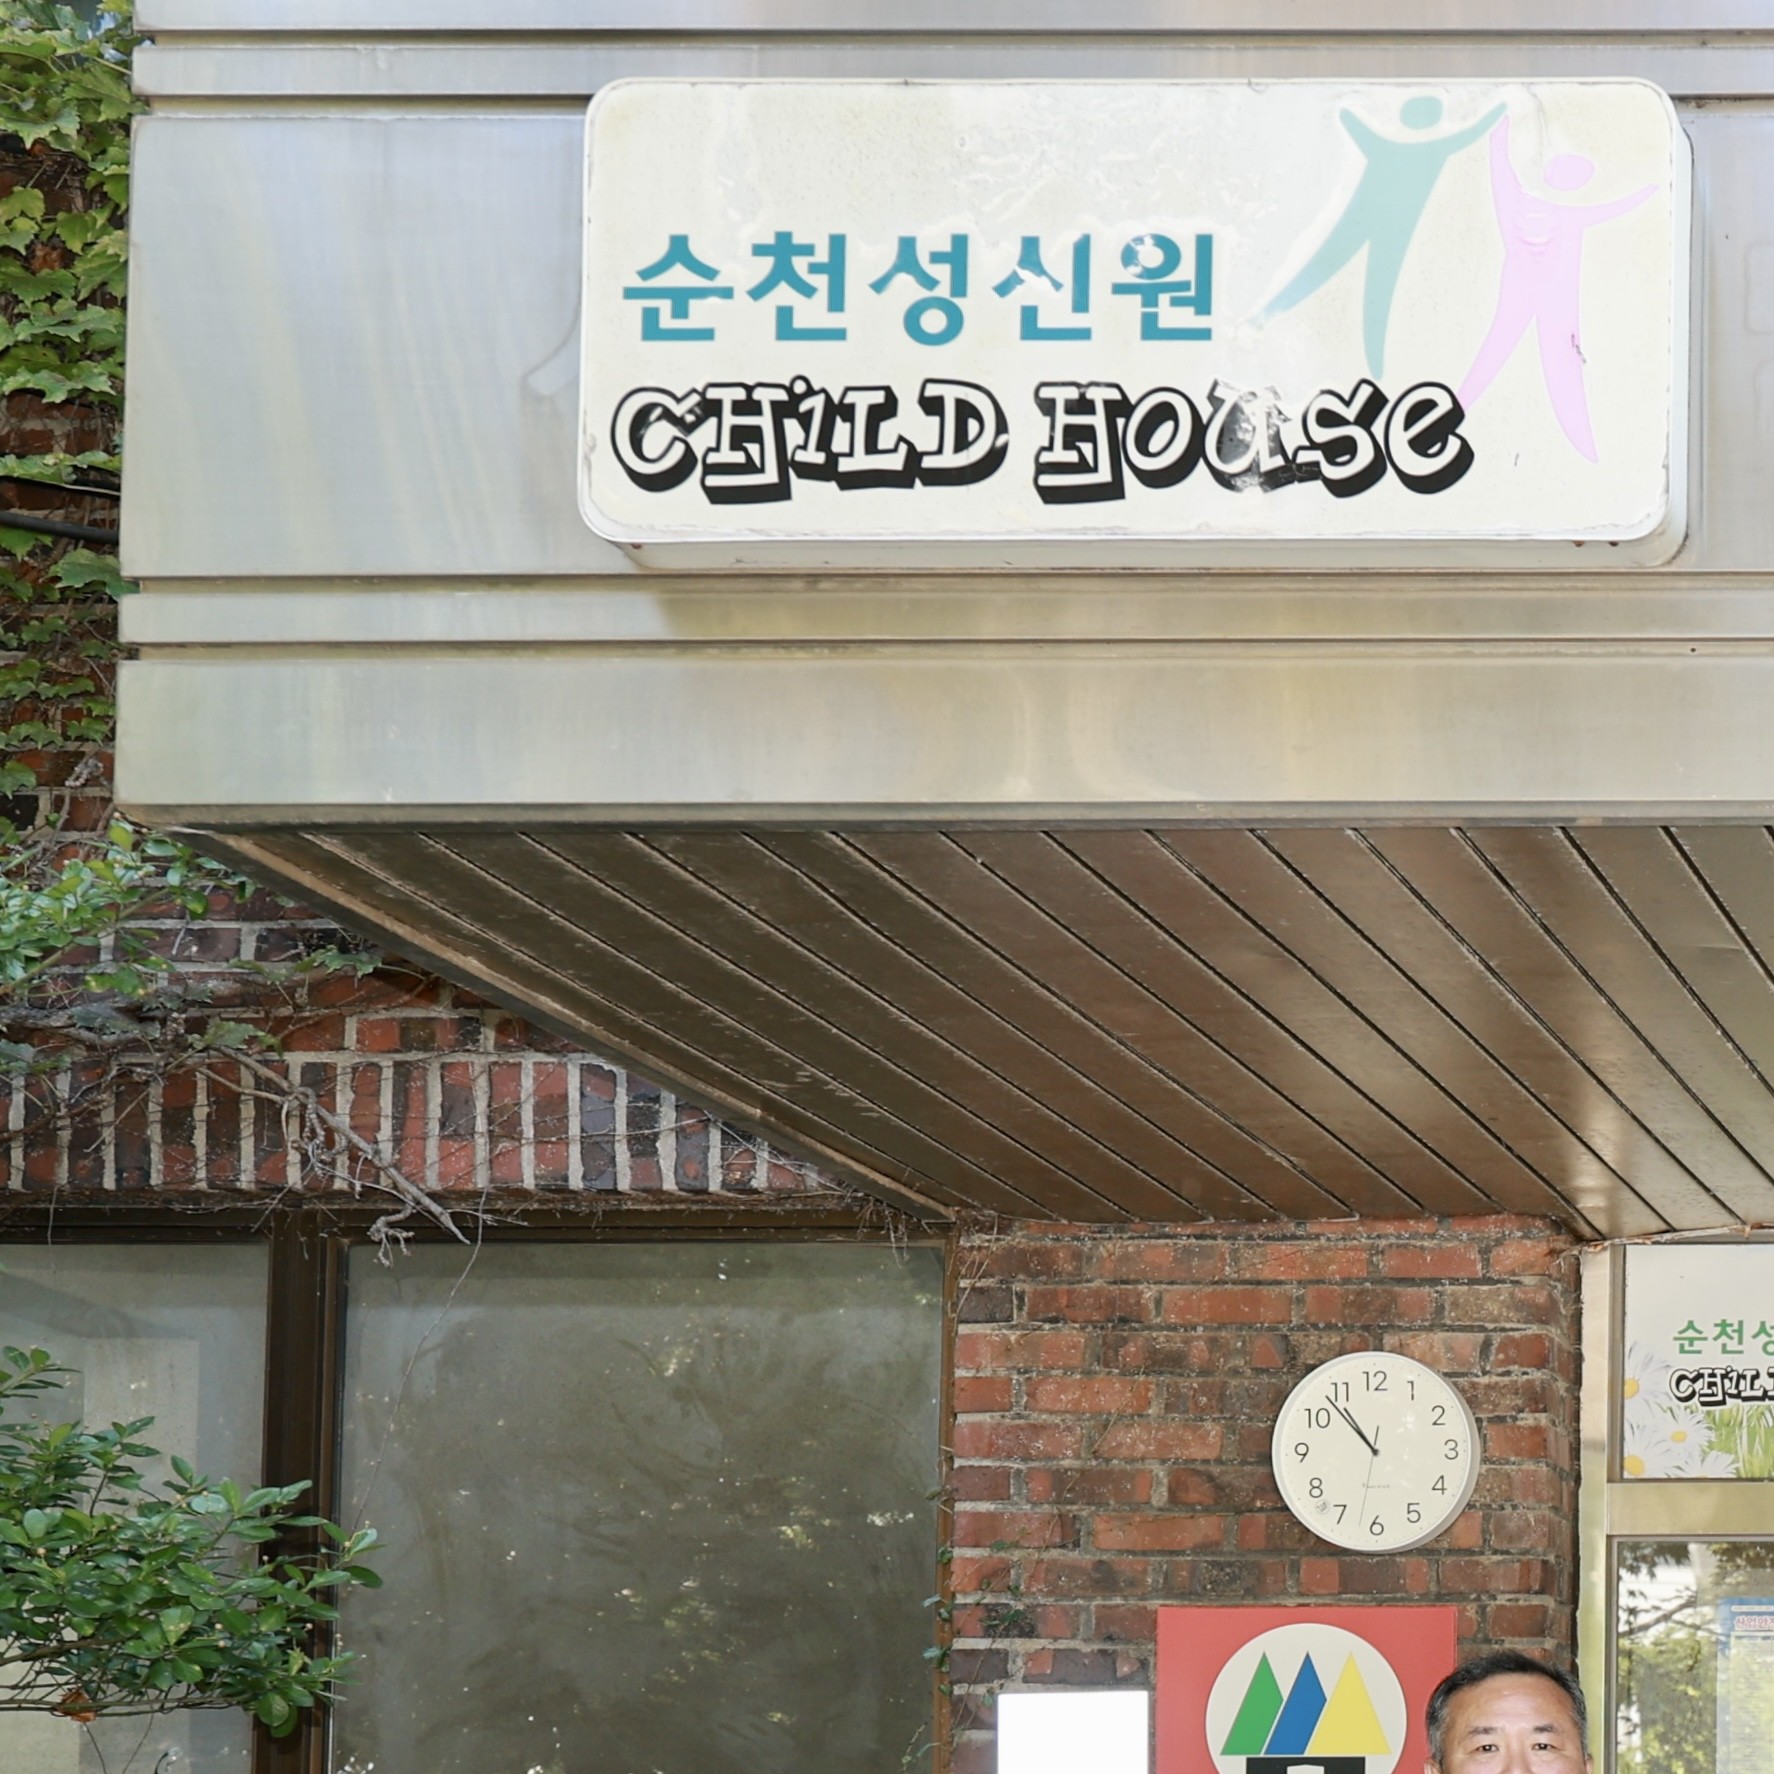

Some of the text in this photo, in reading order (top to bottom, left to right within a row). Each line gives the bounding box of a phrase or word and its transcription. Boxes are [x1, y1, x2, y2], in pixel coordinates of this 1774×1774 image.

[622, 231, 1214, 345] 순천성신원
[1362, 1371, 1388, 1391] 12
[1407, 1380, 1415, 1401] 1
[1331, 1382, 1349, 1402] 11
[1304, 1407, 1331, 1428] 10
[1431, 1405, 1446, 1426] 2
[1294, 1442, 1309, 1463] 9
[1444, 1439, 1459, 1460] 3
[1309, 1477, 1324, 1498] 8
[1431, 1475, 1447, 1495] 4
[1333, 1504, 1347, 1525] 7
[1406, 1503, 1421, 1523] 5
[1369, 1515, 1384, 1536] 6
